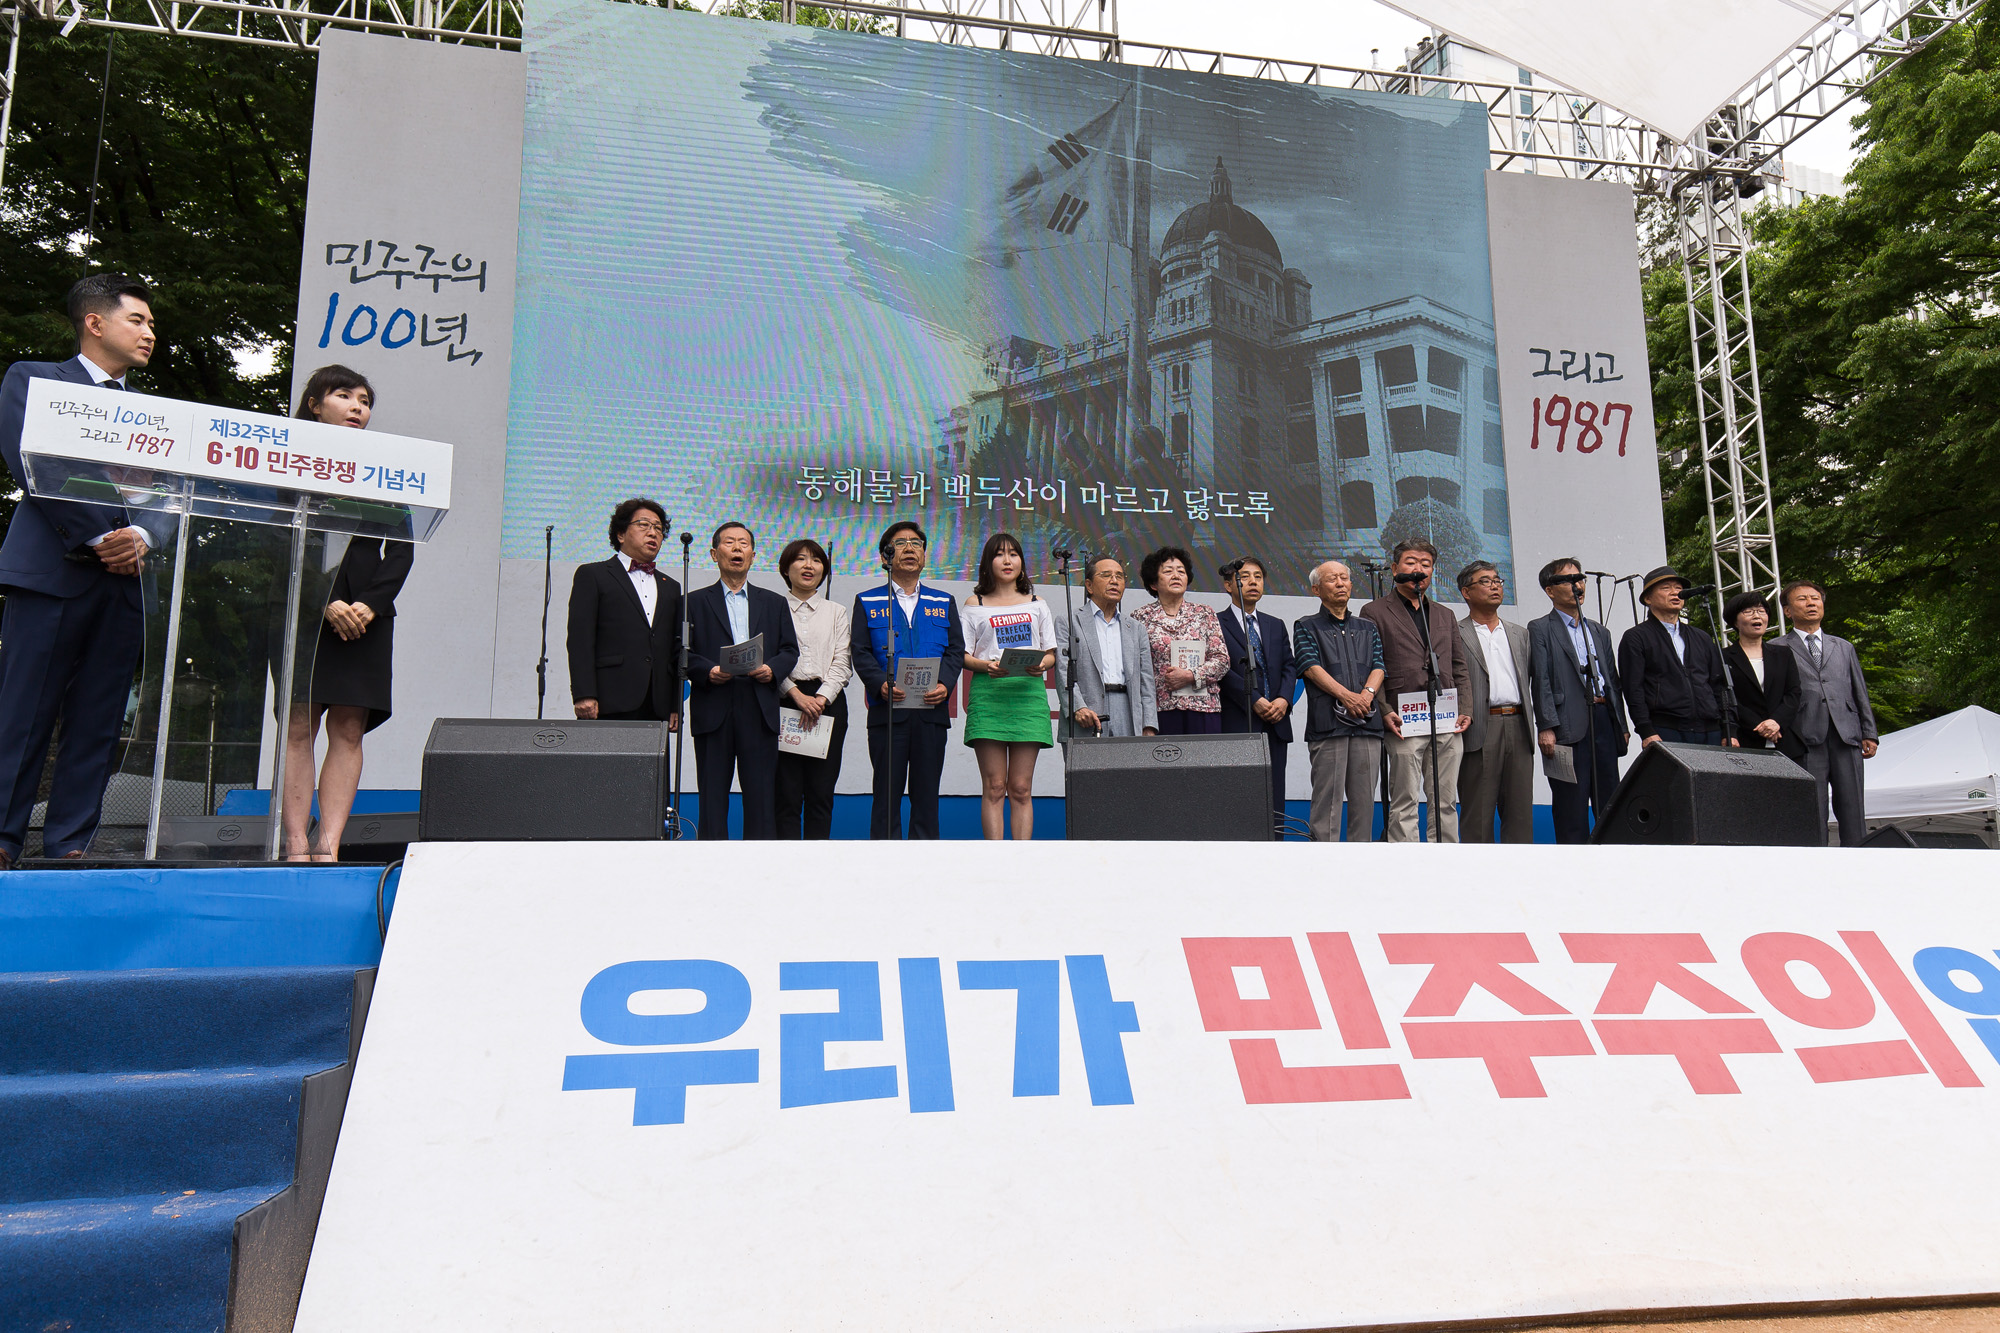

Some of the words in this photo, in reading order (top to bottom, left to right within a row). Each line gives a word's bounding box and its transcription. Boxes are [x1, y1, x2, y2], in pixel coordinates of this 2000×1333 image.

[326, 240, 487, 293] 민주주의
[318, 291, 483, 368] 100년,
[1529, 348, 1624, 384] 그리고
[50, 401, 108, 420] 민주주의
[113, 405, 169, 433] 100년,
[209, 418, 289, 447] 제32주년
[1530, 393, 1633, 457] 1987
[80, 427, 122, 443] 그리고
[126, 433, 175, 457] 1987
[267, 451, 356, 483] 민주항쟁
[362, 465, 426, 494] 기념식
[796, 465, 931, 506] 동해물과
[941, 473, 1066, 514] 백두산이
[1079, 481, 1174, 516] 마르고
[1183, 486, 1275, 524] 닳도록
[924, 606, 946, 618] 농성단
[992, 613, 1031, 627] FEMINISM
[996, 623, 1030, 635] PERFECTS
[997, 633, 1031, 645] DEMOCRACY
[1402, 702, 1428, 713] 우리가
[562, 954, 1141, 1126] 우리가
